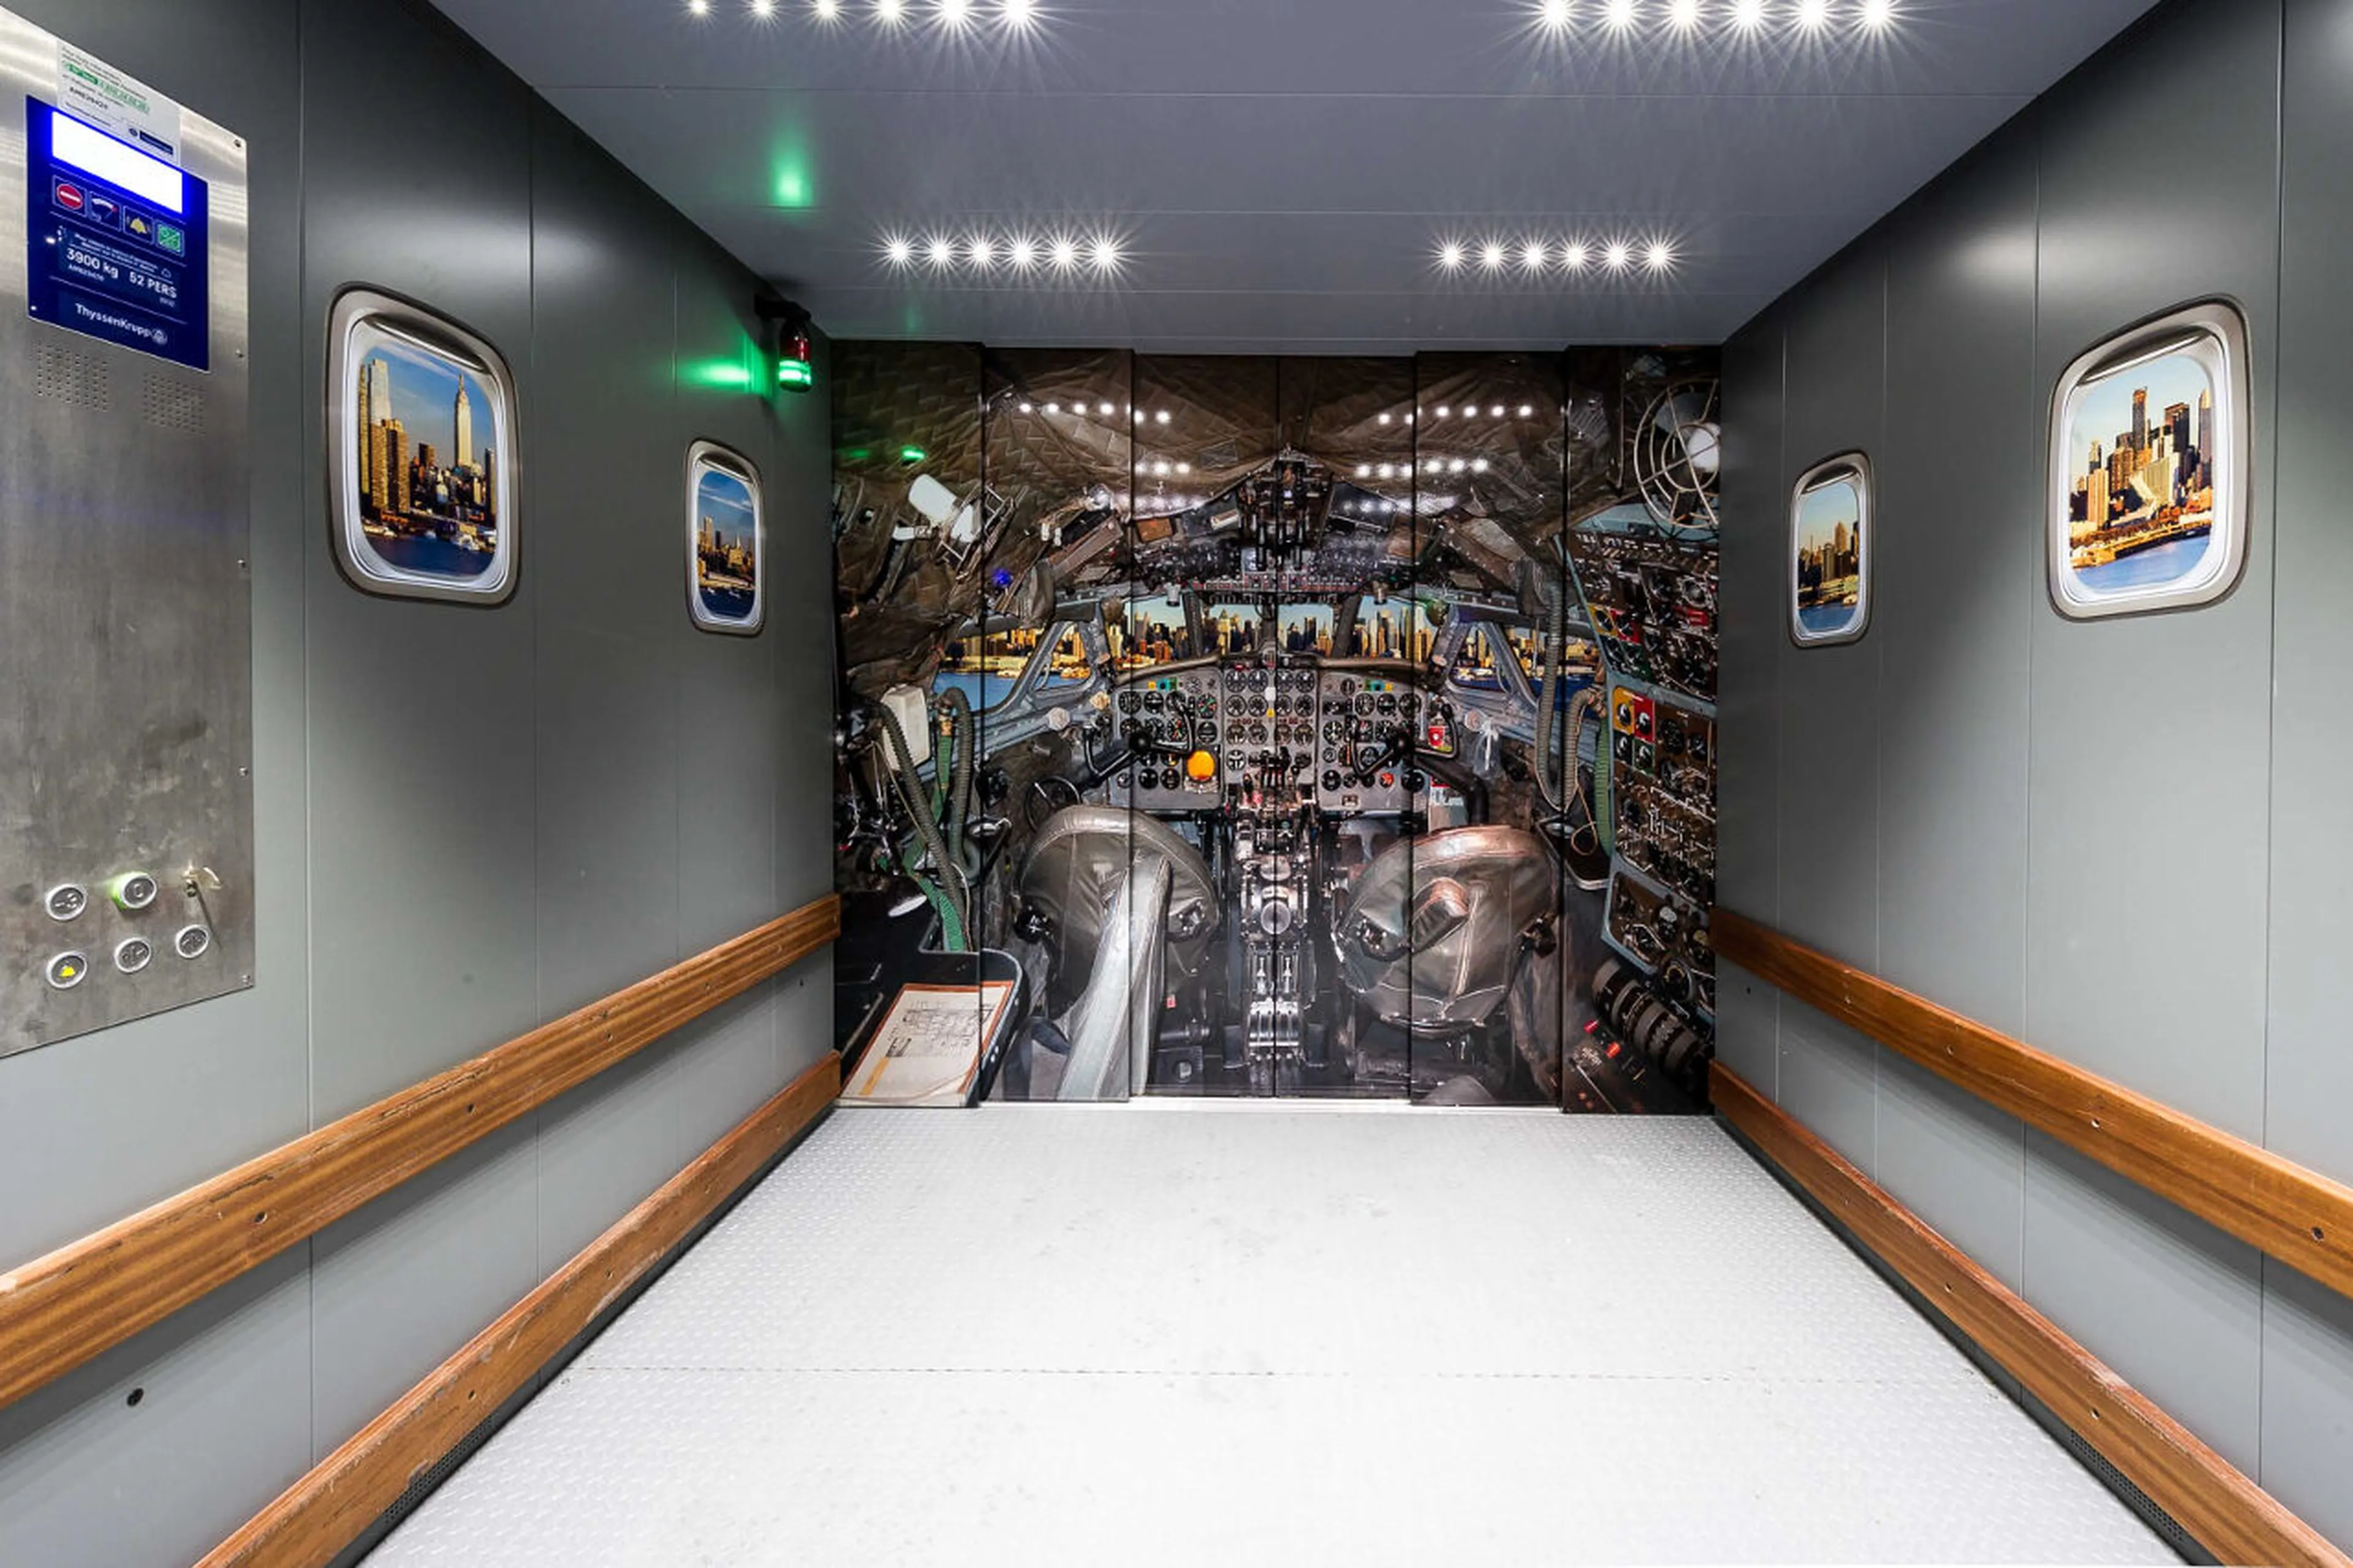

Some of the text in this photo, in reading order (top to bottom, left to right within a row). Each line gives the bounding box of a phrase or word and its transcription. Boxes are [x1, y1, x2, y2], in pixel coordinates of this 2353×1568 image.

[67, 248, 100, 269] 3900
[103, 262, 119, 279] kg
[129, 271, 145, 286] 52
[146, 278, 178, 299] PERS
[75, 303, 152, 337] ThyssenKrupp
